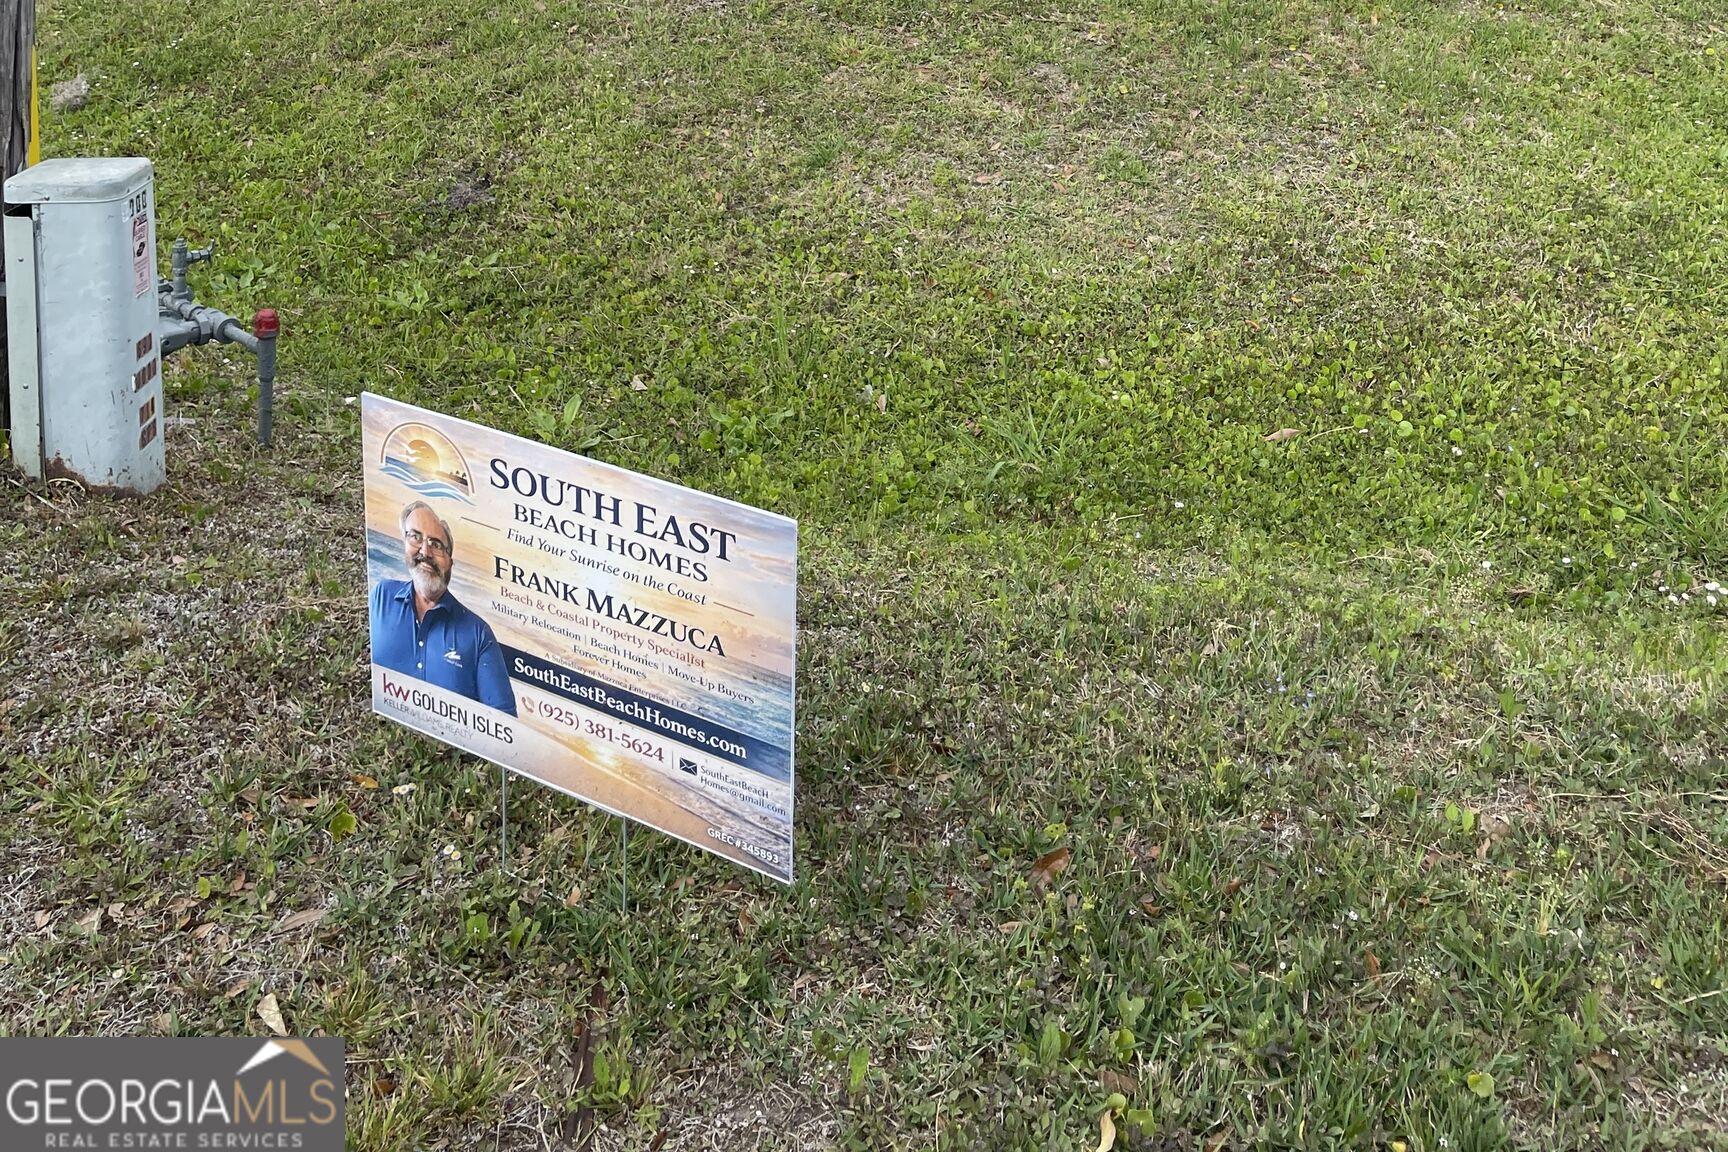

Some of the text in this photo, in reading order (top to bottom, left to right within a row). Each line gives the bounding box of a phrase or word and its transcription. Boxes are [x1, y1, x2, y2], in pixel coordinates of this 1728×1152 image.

[490, 458, 737, 562] SOUTH EAST
[514, 503, 708, 582] BEACH HOMES
[507, 528, 707, 605] Find Your Sunrise on the Coast
[493, 555, 727, 657] FRANK MAZZUCA
[500, 586, 705, 669] Beach & Coastal Property Specialist
[491, 600, 755, 704] Military Relocation Beach Homes Move-Up Buyers
[572, 644, 647, 679] Forever Homes
[383, 673, 513, 744] kw GOLDEN ISLES
[514, 657, 747, 759] SouthEastBeachHomes.com
[538, 700, 665, 763] (925) 381-5624
[700, 776, 786, 816] Homes@gmail.com
[707, 826, 779, 864] GREC #345893
